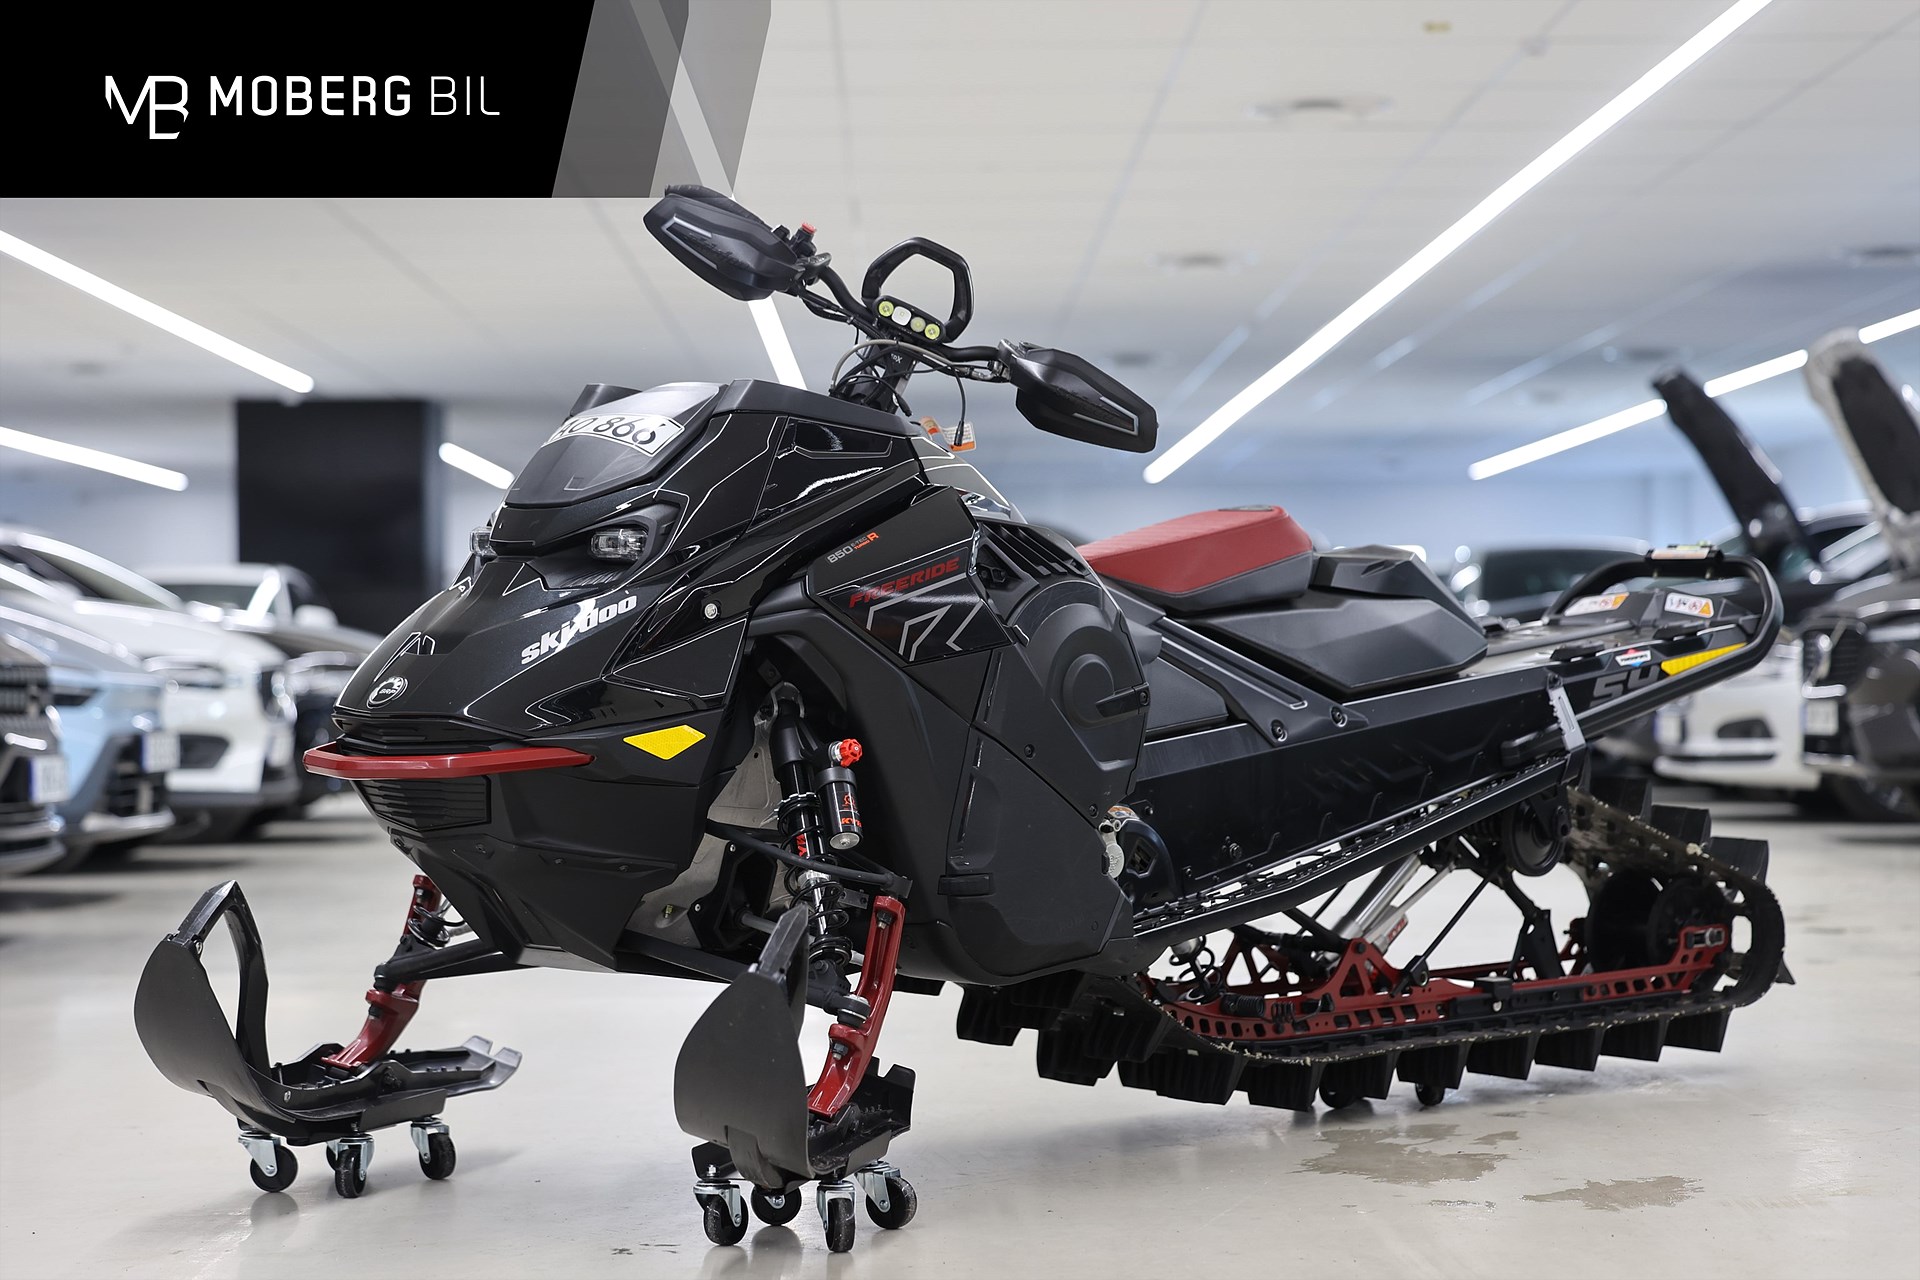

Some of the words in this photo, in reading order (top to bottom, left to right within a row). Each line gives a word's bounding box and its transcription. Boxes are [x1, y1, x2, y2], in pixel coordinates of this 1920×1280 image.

[826, 545, 854, 563] 850
[866, 532, 879, 541] R
[848, 556, 961, 609] FREERIDE
